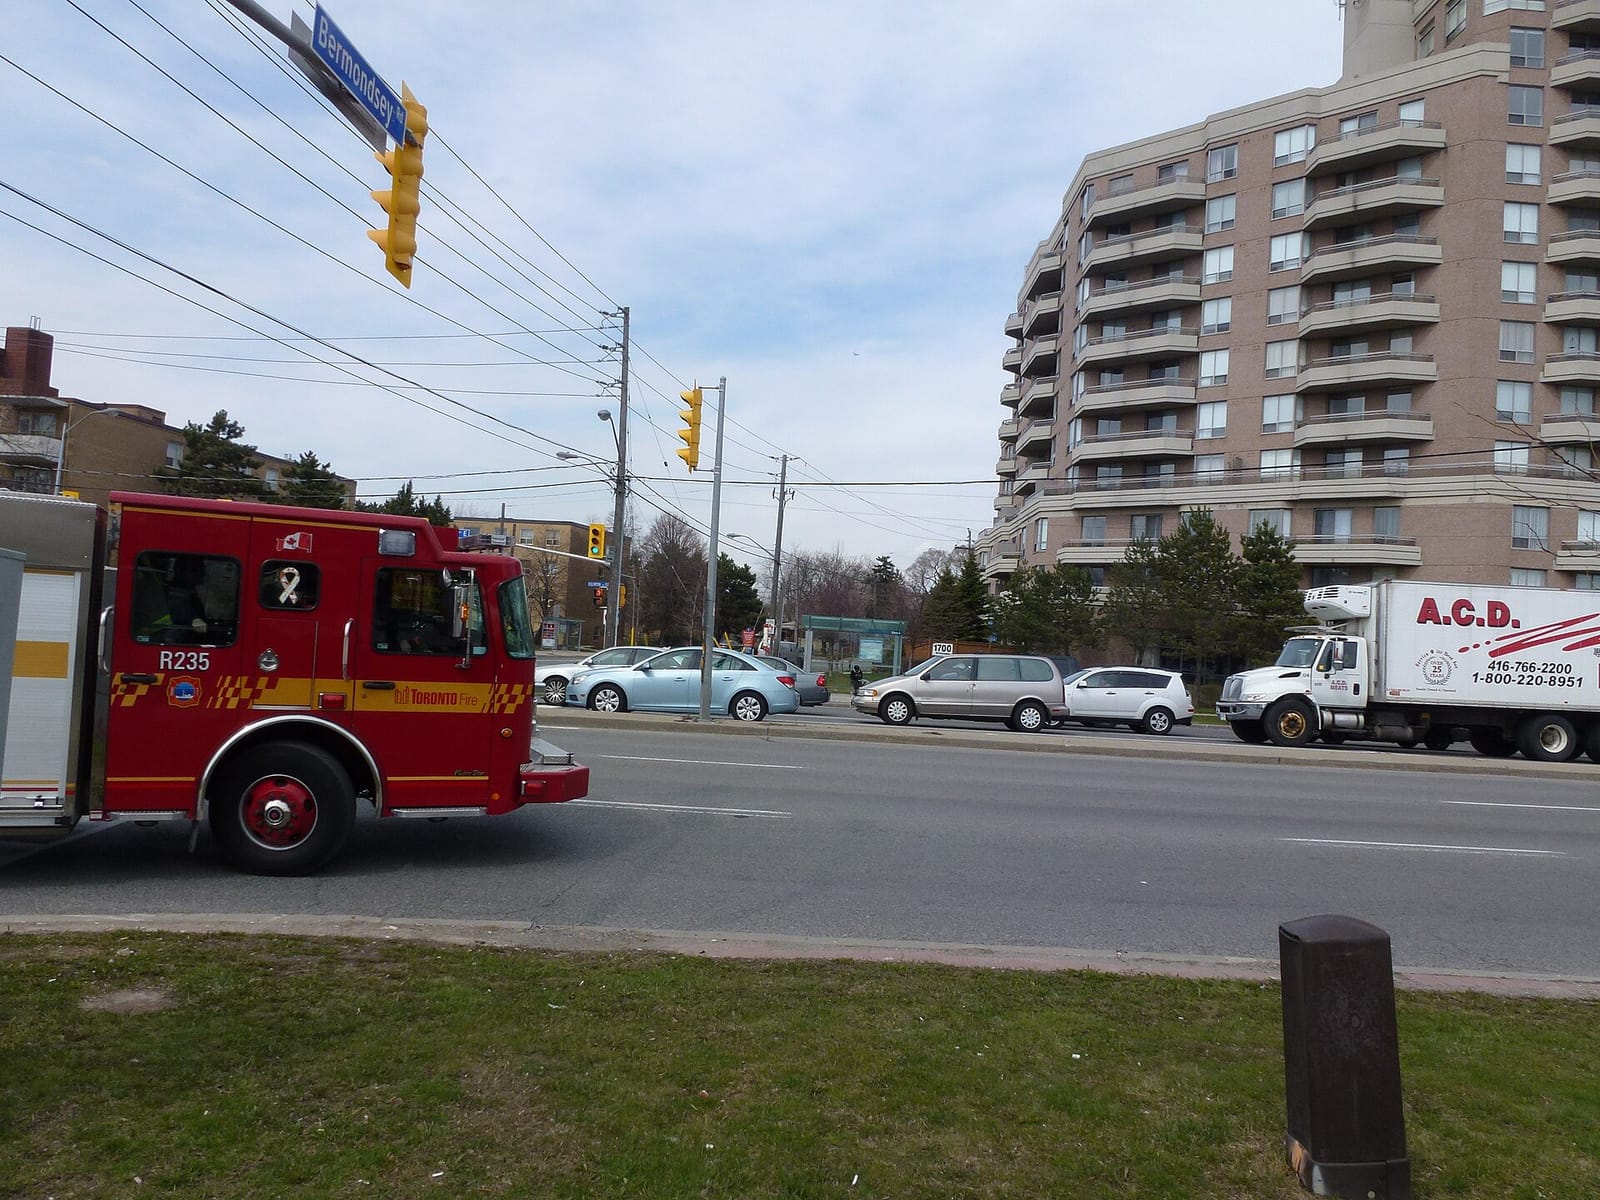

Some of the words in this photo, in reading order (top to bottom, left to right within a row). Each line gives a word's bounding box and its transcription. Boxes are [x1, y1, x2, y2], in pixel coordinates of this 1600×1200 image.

[318, 15, 394, 129] Bermondsey
[1417, 597, 1521, 629] A.C.D.
[934, 644, 951, 652] 1700
[160, 650, 210, 670] R235
[1487, 660, 1572, 675] 416-766-2200
[1432, 665, 1442, 673] 25
[1472, 672, 1584, 688] 1-800-220-8951
[411, 688, 458, 705] TORONTO
[459, 692, 478, 706] Fire
